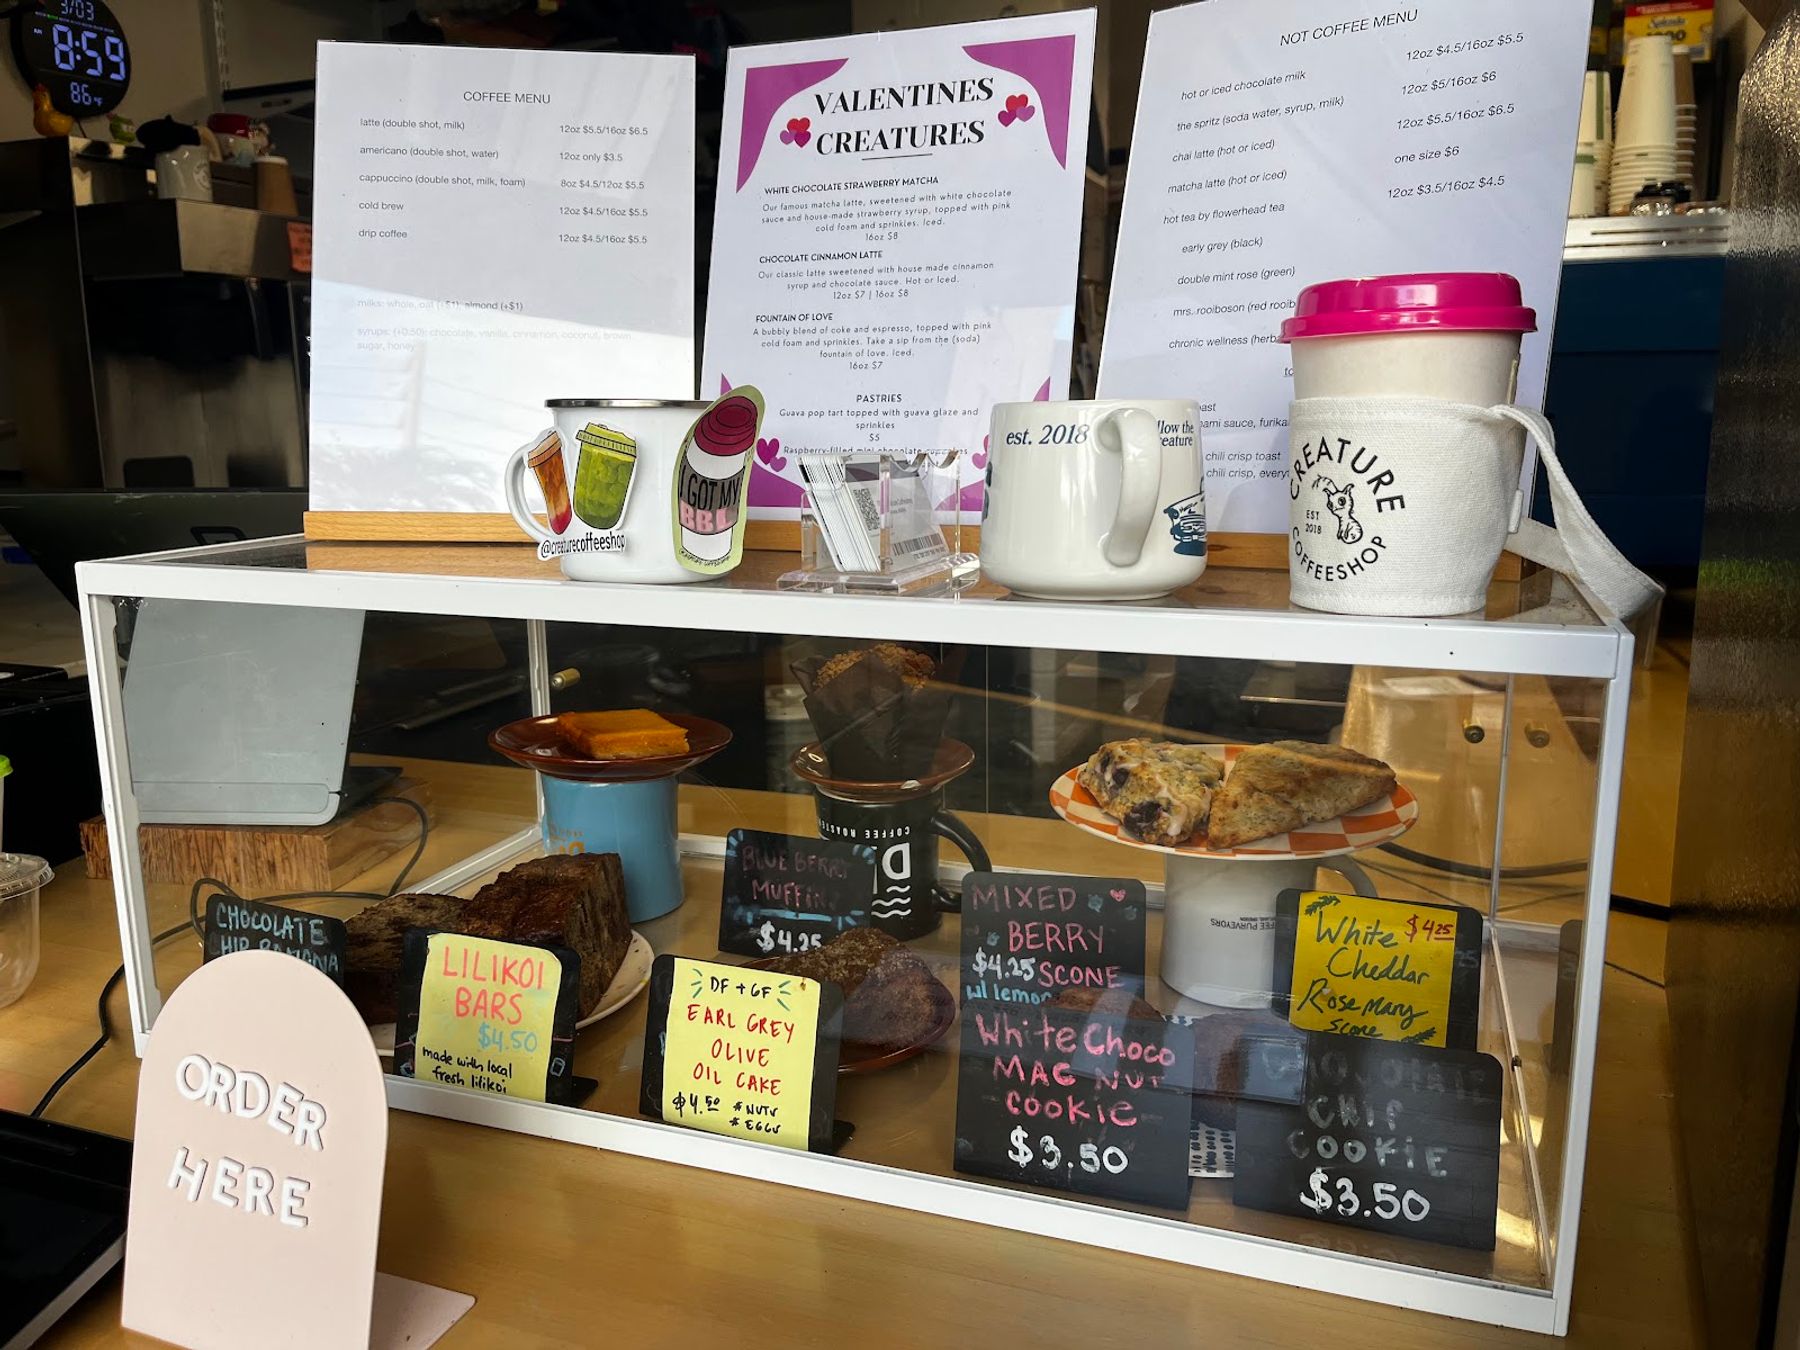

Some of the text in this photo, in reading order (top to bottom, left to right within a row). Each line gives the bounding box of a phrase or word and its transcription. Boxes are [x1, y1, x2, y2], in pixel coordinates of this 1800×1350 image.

[1279, 9, 1418, 47] NOT COFFEE MENU
[52, 23, 126, 81] 8:59
[1406, 32, 1524, 61] 12oz $4.5/16oz $5.5
[463, 91, 551, 104] COFFEE MENU
[814, 77, 995, 116] VALENTINES
[1181, 70, 1307, 101] hot or iced chocolate milk
[1401, 70, 1497, 96] 12oz $5/16oz $6
[360, 118, 465, 131] latte (double shot, milk)
[1177, 95, 1345, 132] the spritz (soda water, syrup, milk)
[1397, 103, 1515, 130] 12oz $5.5/16oz $6.5
[559, 125, 648, 136] 12oz $5.5/16oz $6.5
[816, 120, 986, 156] CREATURES
[360, 146, 499, 159] americano (double shot, water)
[559, 152, 623, 163] 12oz only $3.5
[1394, 145, 1460, 165] one size $6
[764, 176, 939, 195] WHITE CHOCOLATE STRAWBERRY MATCHA
[1387, 175, 1505, 199] 12oz $3.5/16oz $4.5
[358, 201, 404, 211] cold brew
[1163, 202, 1286, 225] hot tea by flowerhead tea
[358, 228, 408, 239] drip coffee
[1182, 237, 1264, 254] early grey (black)
[759, 250, 883, 264] CHOCOLATE CINNAMON LATTE
[1177, 266, 1296, 285] double mint rose (green)
[755, 312, 834, 323] FOUNTAIN OF LOVE
[779, 408, 979, 418] Guava pop tart topped with guava glaze and
[856, 394, 903, 403] PASTRIES
[1006, 423, 1090, 446] est. 2018
[1181, 420, 1195, 434] the
[1205, 451, 1281, 463] chili crisp toast
[1290, 436, 1406, 513] CREATURE
[688, 473, 717, 511] GOT
[719, 478, 740, 509] MY
[680, 500, 736, 533] BBL
[1305, 523, 1322, 534] 2018
[540, 531, 625, 559] @creaturecoffeeshop
[1292, 526, 1387, 582] COFFEESHOP
[972, 884, 1077, 912] MIXED
[216, 902, 326, 945] CHOCOLATE
[756, 920, 822, 953] $4.25
[1007, 920, 1105, 953] BERRY
[1315, 911, 1398, 948] White
[442, 946, 545, 990] LILIKOI
[972, 946, 1125, 988] $4.25 SCONE
[1326, 946, 1430, 984] Cheddar
[710, 976, 730, 994] DF
[750, 983, 772, 999] GF
[455, 989, 524, 1025] BARS
[478, 1022, 538, 1053] $4.50
[687, 1004, 795, 1044] EARL GREY
[975, 1012, 1077, 1053] White
[422, 1045, 514, 1079] made with local
[710, 1038, 770, 1068] OLIVE
[432, 1065, 466, 1087] fresh
[693, 1062, 781, 1096] OIL CAKE
[992, 1054, 1077, 1088] MAC
[174, 1053, 328, 1152] ORDER
[1007, 1125, 1129, 1175] $3.50
[167, 1146, 312, 1229] HERE
[1300, 1167, 1431, 1222] $3.50
